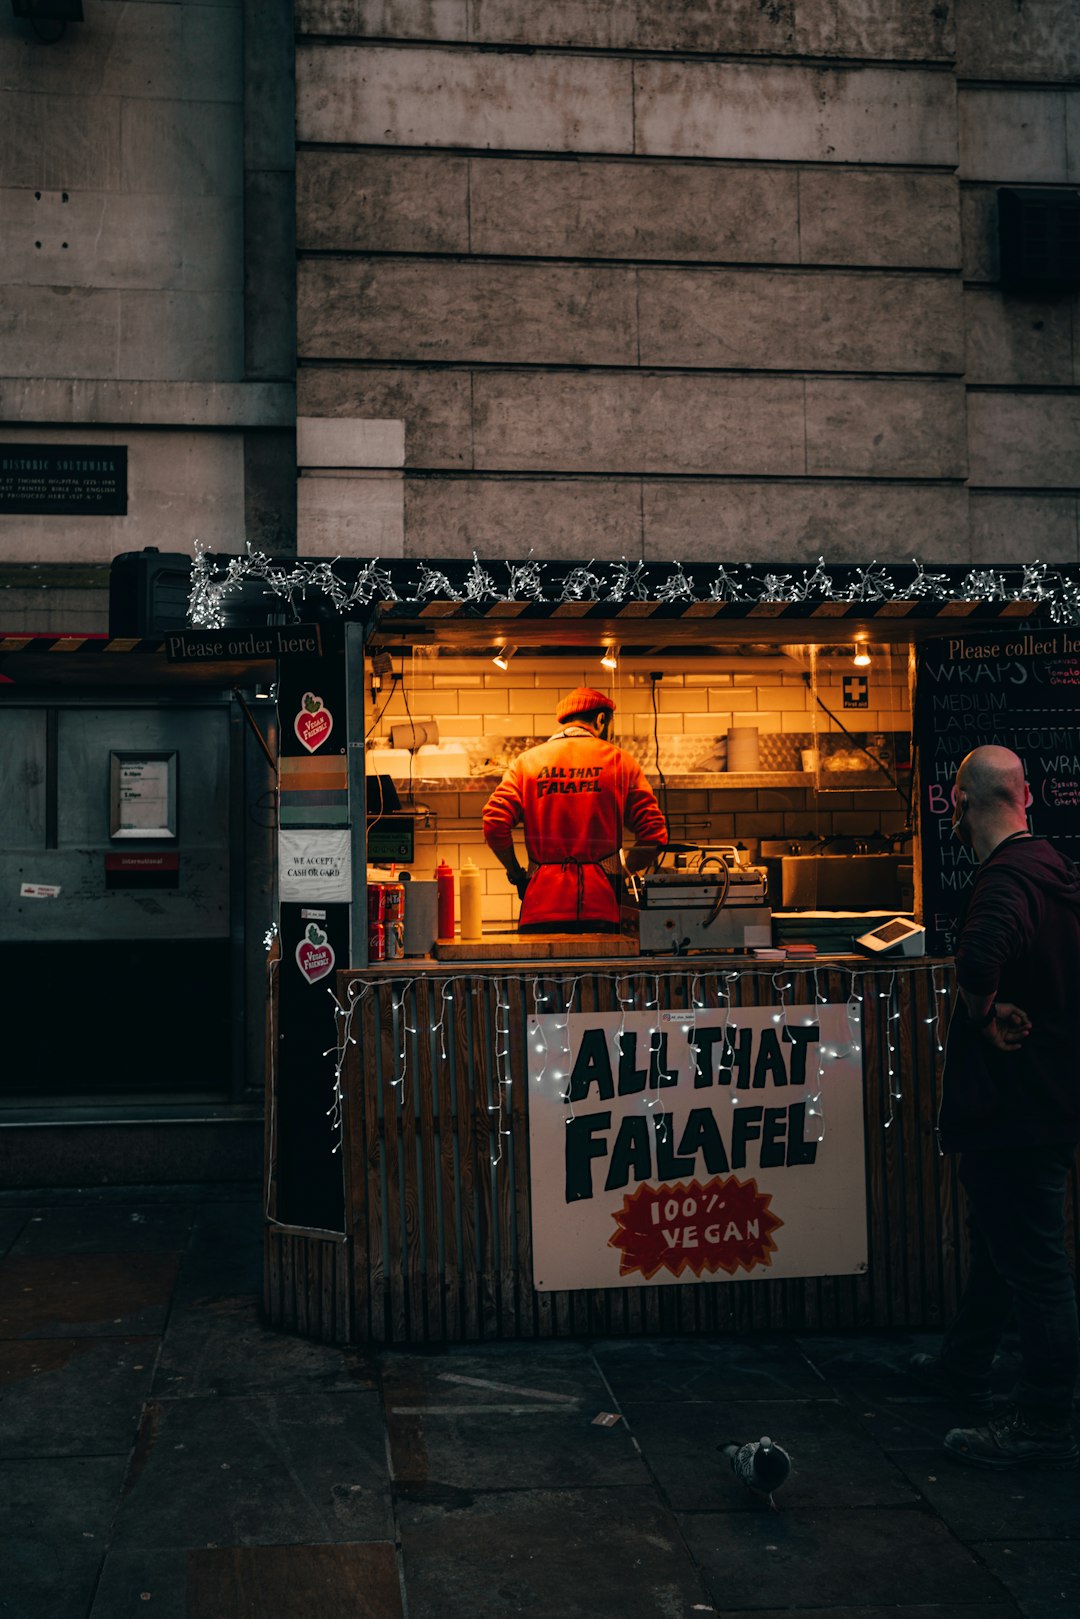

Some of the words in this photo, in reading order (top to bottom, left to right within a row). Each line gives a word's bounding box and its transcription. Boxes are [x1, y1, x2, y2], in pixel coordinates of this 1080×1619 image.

[3, 460, 48, 471] HISTORIC
[56, 460, 115, 471] SOUTHWARK
[169, 636, 223, 658] Please
[228, 632, 273, 655] order
[277, 631, 316, 653] here
[948, 639, 1001, 660] Please
[1004, 634, 1058, 657] collect
[932, 692, 1007, 711] MEDIUM
[933, 712, 1009, 733] LARGE
[537, 766, 566, 780] ALL
[568, 766, 604, 778] THAT
[537, 780, 602, 798] FALAFEL
[293, 857, 305, 865] WE
[306, 857, 334, 865] ACCEPT
[287, 868, 307, 877] CASH
[308, 868, 319, 877] OR
[563, 1028, 679, 1104] ALL
[687, 1025, 820, 1090] THAT
[565, 1101, 819, 1205] FALAFEL
[649, 1193, 727, 1225] 100%
[661, 1217, 761, 1250] VEGAN
